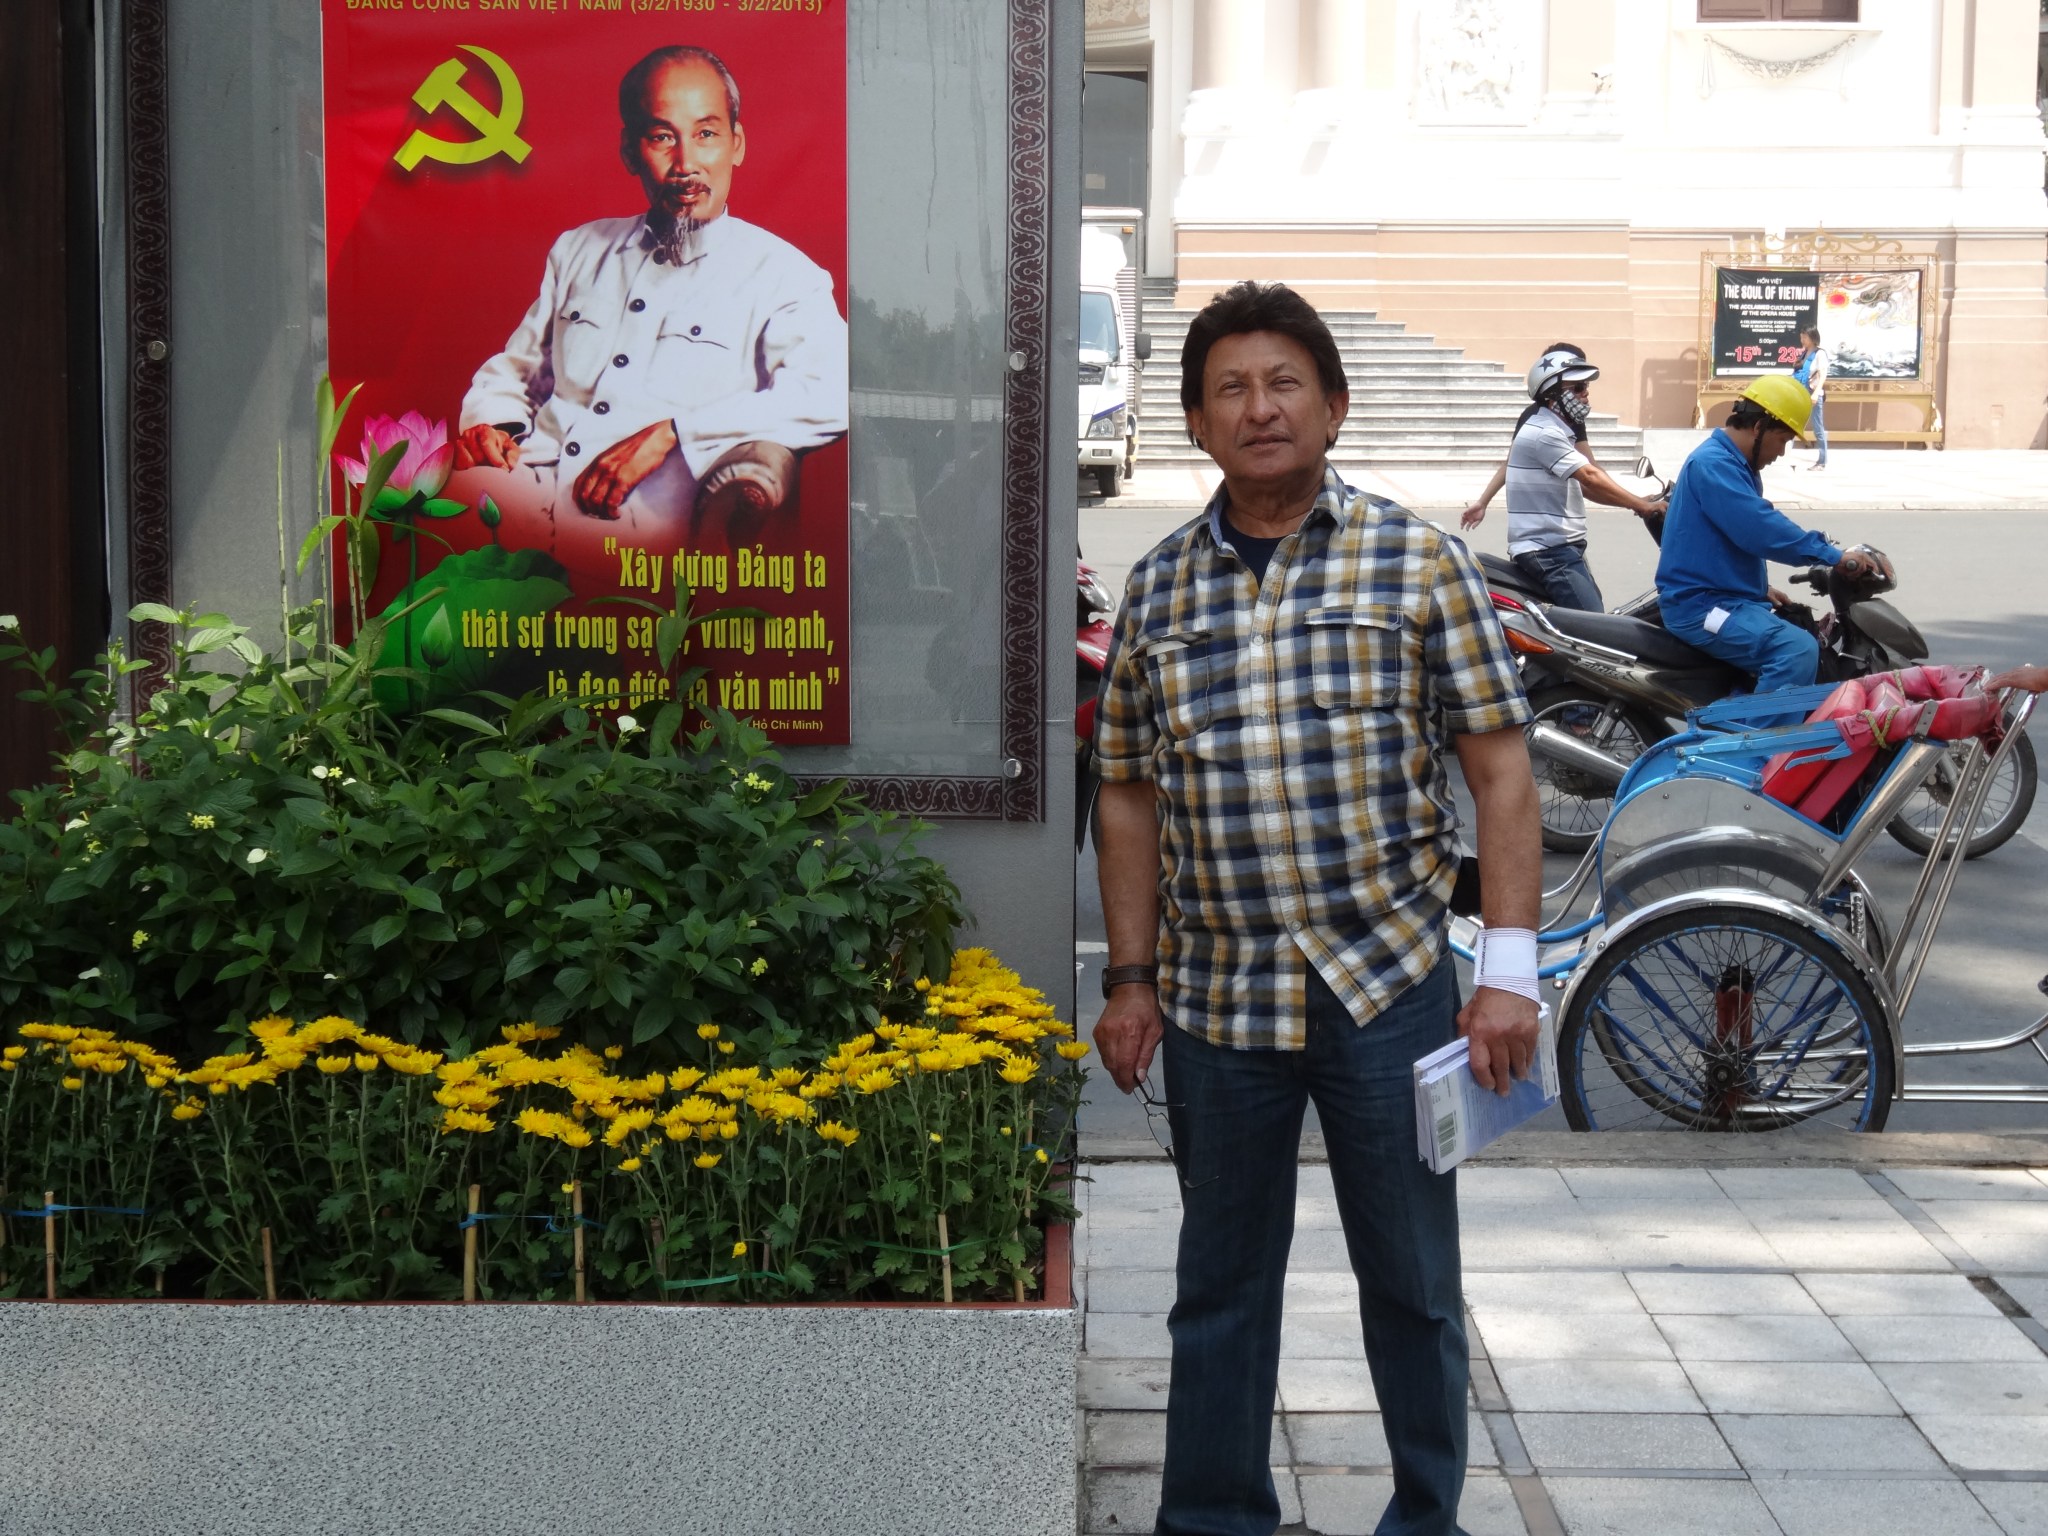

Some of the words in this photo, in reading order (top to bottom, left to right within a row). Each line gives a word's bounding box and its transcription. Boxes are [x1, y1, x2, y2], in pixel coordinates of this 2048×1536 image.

[579, 0, 622, 10] NAM
[1724, 284, 1740, 299] THE
[1741, 285, 1763, 300] SOUL
[1765, 286, 1777, 300] OF
[1779, 286, 1816, 300] VIETNAM
[737, 544, 794, 594] Đảng
[804, 550, 826, 588] ta
[462, 609, 509, 657] thật
[517, 611, 546, 656] sự
[555, 611, 617, 655] trong
[627, 610, 690, 656] sạ,
[764, 610, 834, 656] mạnh,
[719, 671, 760, 710] văn
[792, 720, 823, 732] Minh)
